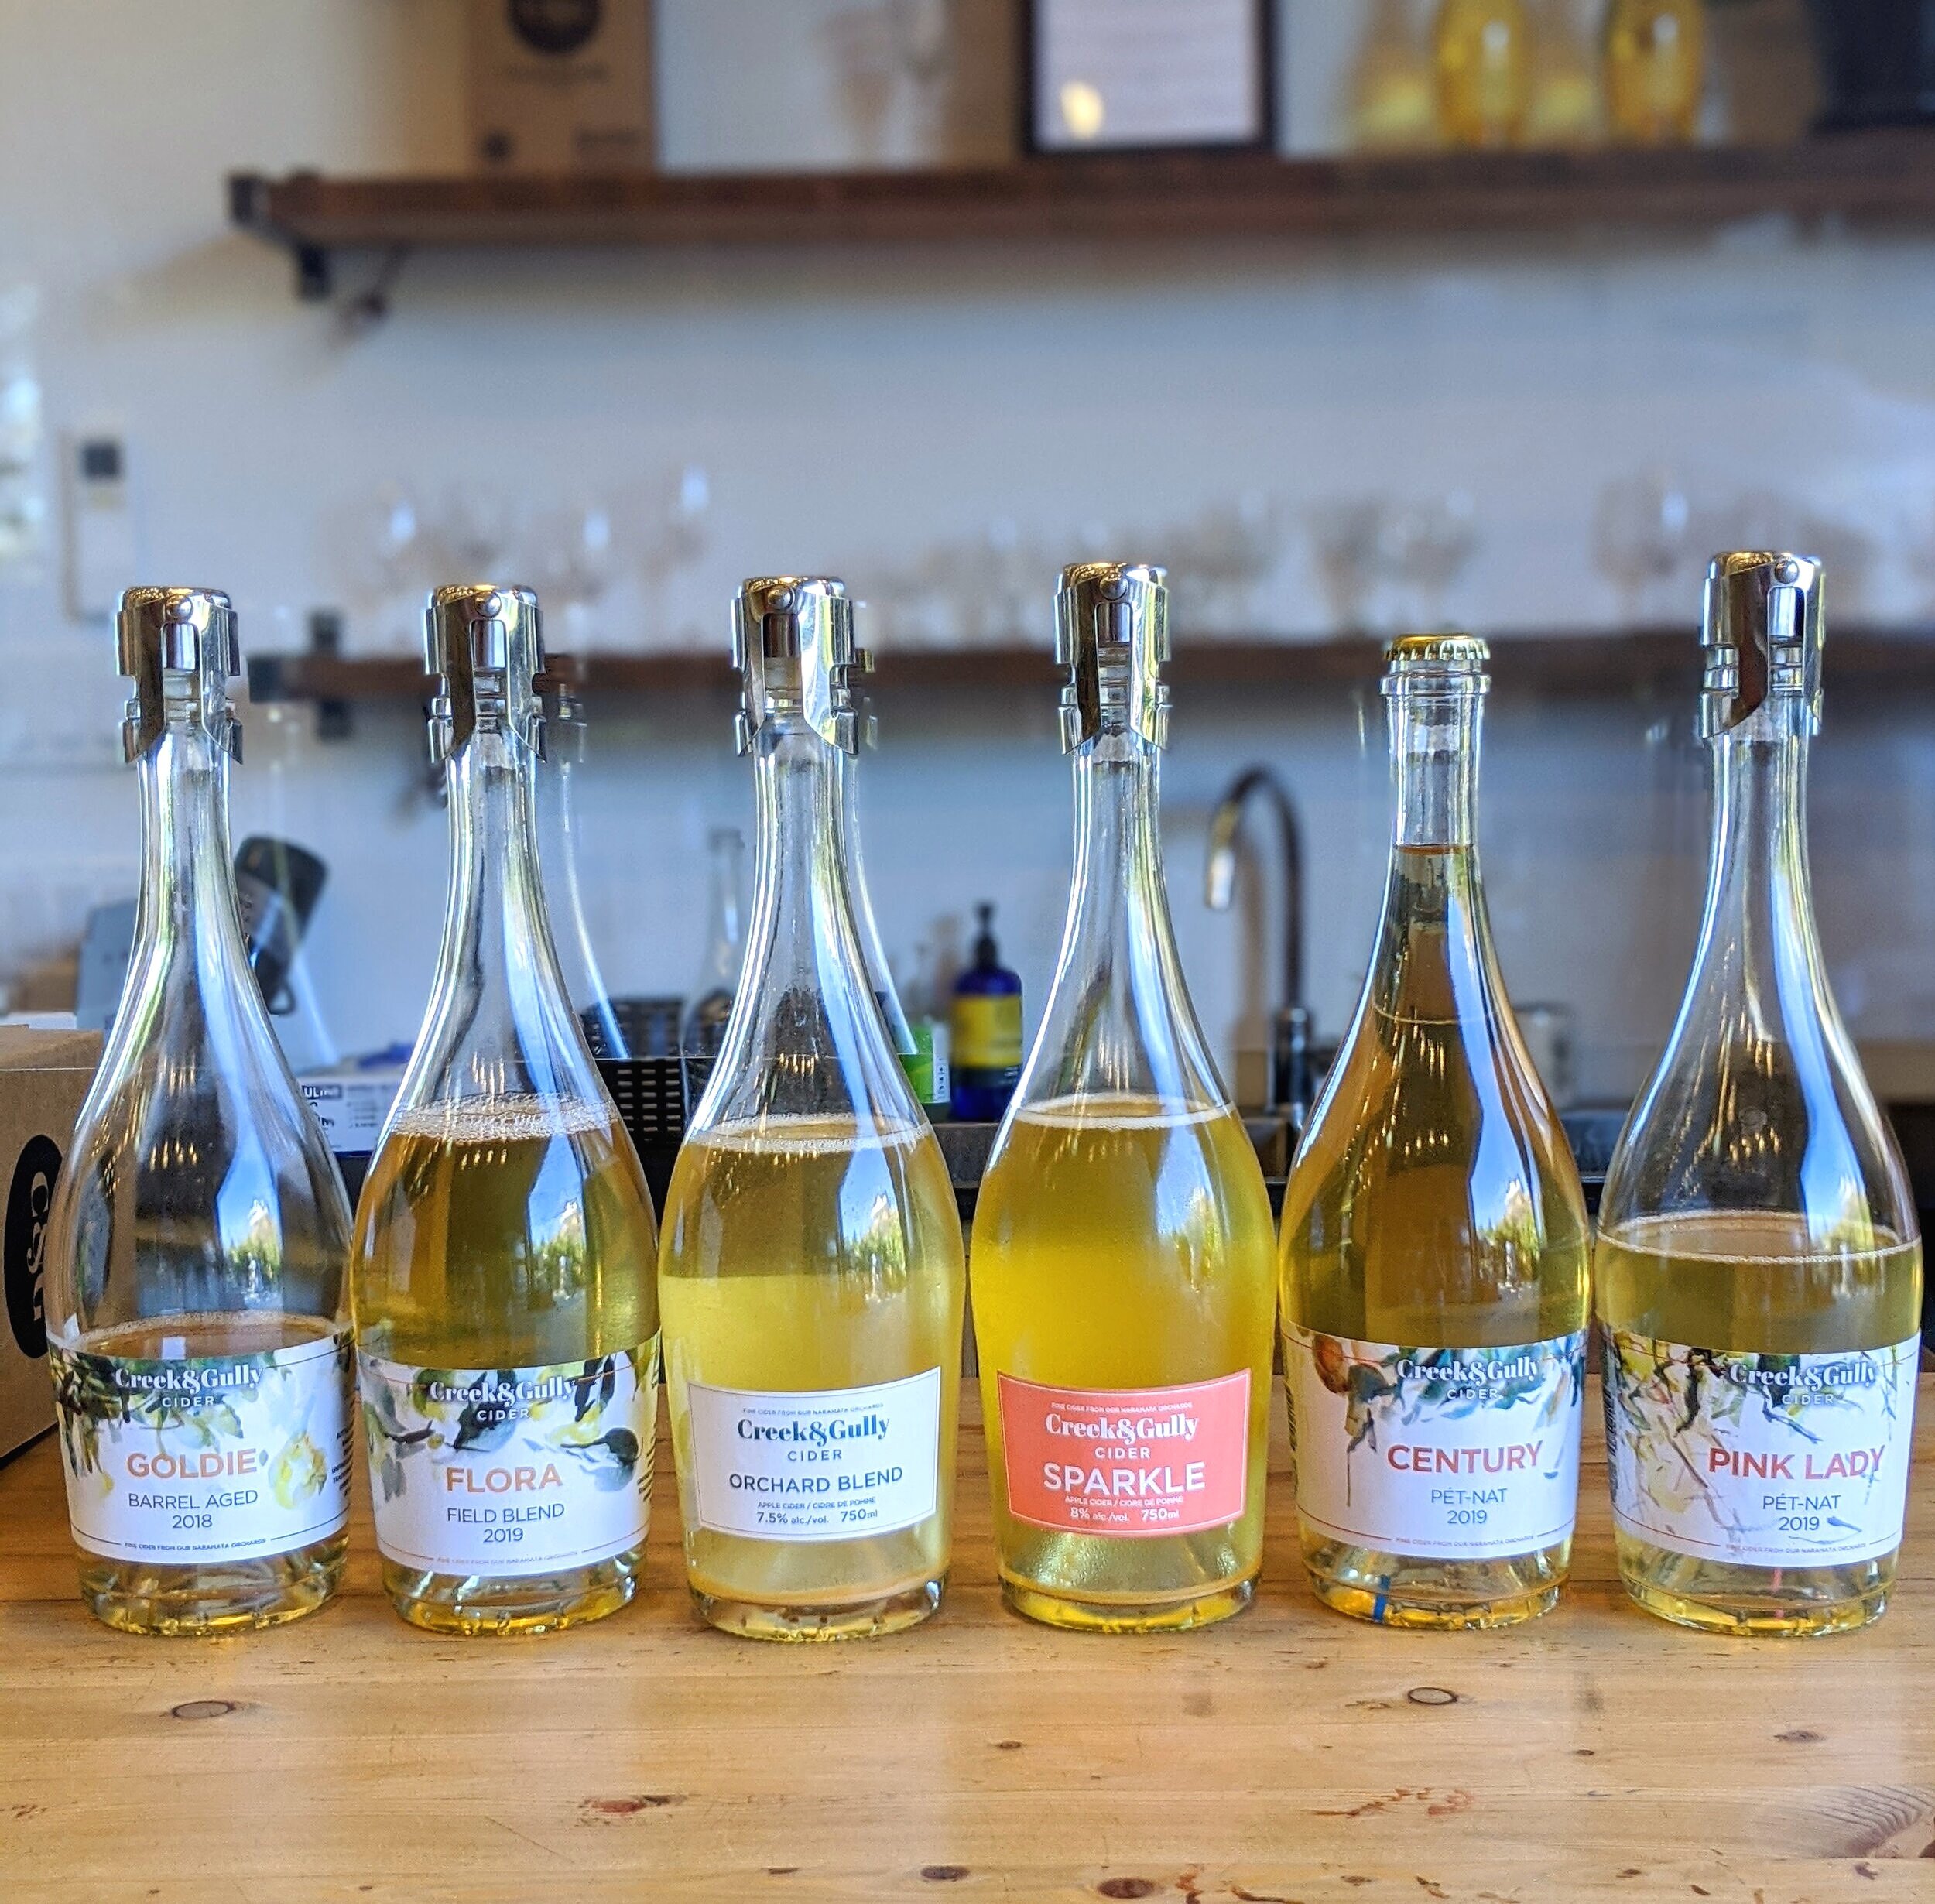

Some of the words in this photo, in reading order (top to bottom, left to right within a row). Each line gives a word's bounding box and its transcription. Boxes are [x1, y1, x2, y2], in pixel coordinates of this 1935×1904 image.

[115, 1365, 263, 1393] Creek&Gully
[1396, 1357, 1538, 1385] Creek&Gully
[1730, 1363, 1875, 1391] Creek&Gully
[430, 1375, 574, 1407] Creek&Gully
[1447, 1389, 1498, 1400] CIDER
[1782, 1394, 1834, 1405] CIDER
[162, 1396, 214, 1408] CIDER
[477, 1408, 530, 1421] CIDER
[738, 1414, 889, 1447] Creek&Gully
[1045, 1413, 1199, 1444] Creek&Gully
[787, 1450, 842, 1461] CIDER
[1095, 1447, 1151, 1459] CIDER
[1387, 1440, 1543, 1474] CENTURY
[1709, 1447, 1794, 1479] PINK
[1806, 1445, 1885, 1479] LADY
[127, 1449, 257, 1478] GOLDIE
[446, 1463, 563, 1492] FLORA
[729, 1474, 830, 1493] ORCHARD
[838, 1467, 902, 1491] BLEND
[1043, 1461, 1205, 1495] SPARKLE
[128, 1493, 200, 1510] BARREL
[206, 1490, 258, 1506] AGED
[1065, 1496, 1087, 1505] APPLE
[1156, 1495, 1183, 1505] POMME
[1431, 1486, 1507, 1505] PÉT-NAT
[1763, 1493, 1841, 1512] PÉT-NAT
[172, 1514, 213, 1529] 2018
[447, 1508, 496, 1523] FIELD
[503, 1503, 564, 1522] BLEND
[756, 1512, 788, 1524] 7.5%
[791, 1515, 829, 1525] alc./vol.
[841, 1508, 878, 1522] 750ml
[1070, 1507, 1090, 1519] 8%
[1141, 1508, 1179, 1521] 750ml
[1447, 1510, 1487, 1524] 2019
[1779, 1517, 1819, 1532] 2019
[483, 1528, 523, 1543] 2019
